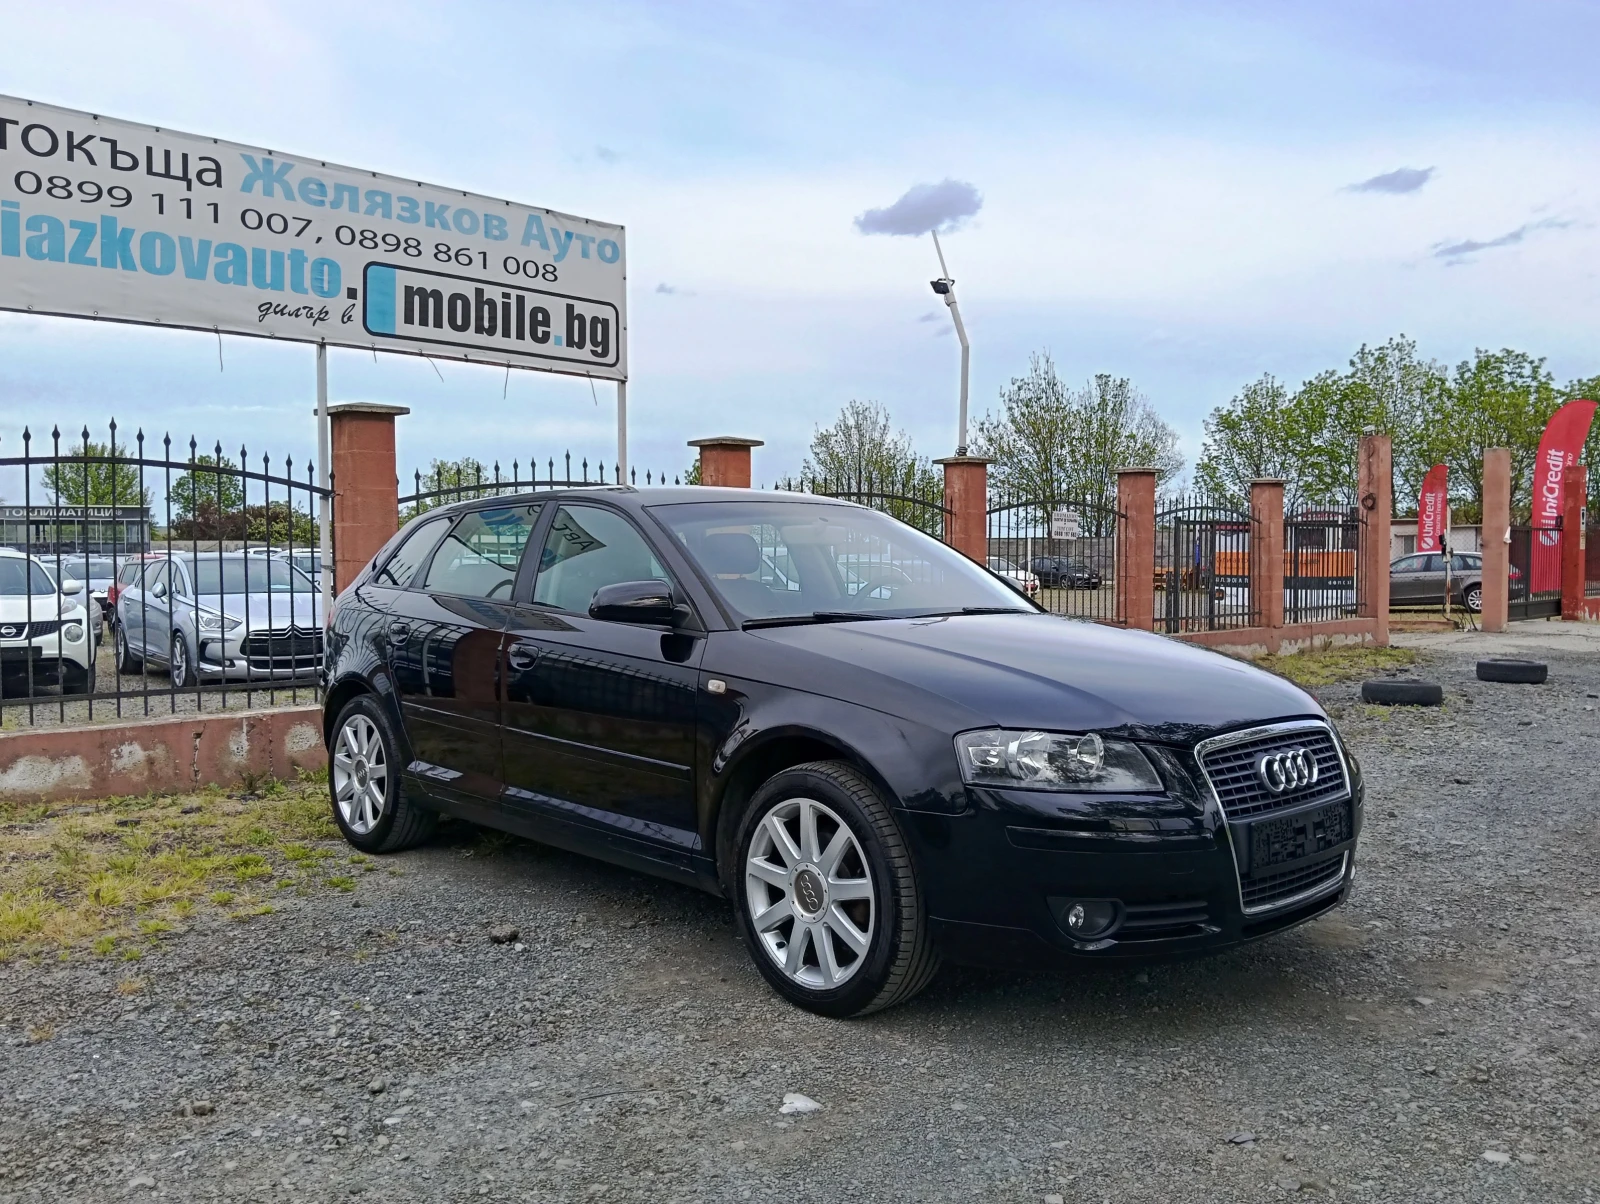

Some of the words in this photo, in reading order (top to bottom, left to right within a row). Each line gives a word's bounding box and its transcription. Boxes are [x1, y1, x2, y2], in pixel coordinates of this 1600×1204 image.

[14, 170, 133, 208] 0899
[151, 193, 219, 224] 111
[240, 208, 323, 244] 007,
[335, 225, 422, 258] 0898
[433, 243, 488, 270] 861
[503, 256, 558, 282] 008
[239, 153, 509, 242] Желязков
[521, 213, 620, 264] Ауто
[257, 301, 331, 327] дилър
[403, 284, 610, 359] mobile.bg
[1422, 493, 1435, 537] UniCredit
[1541, 449, 1564, 525] UniCredit
